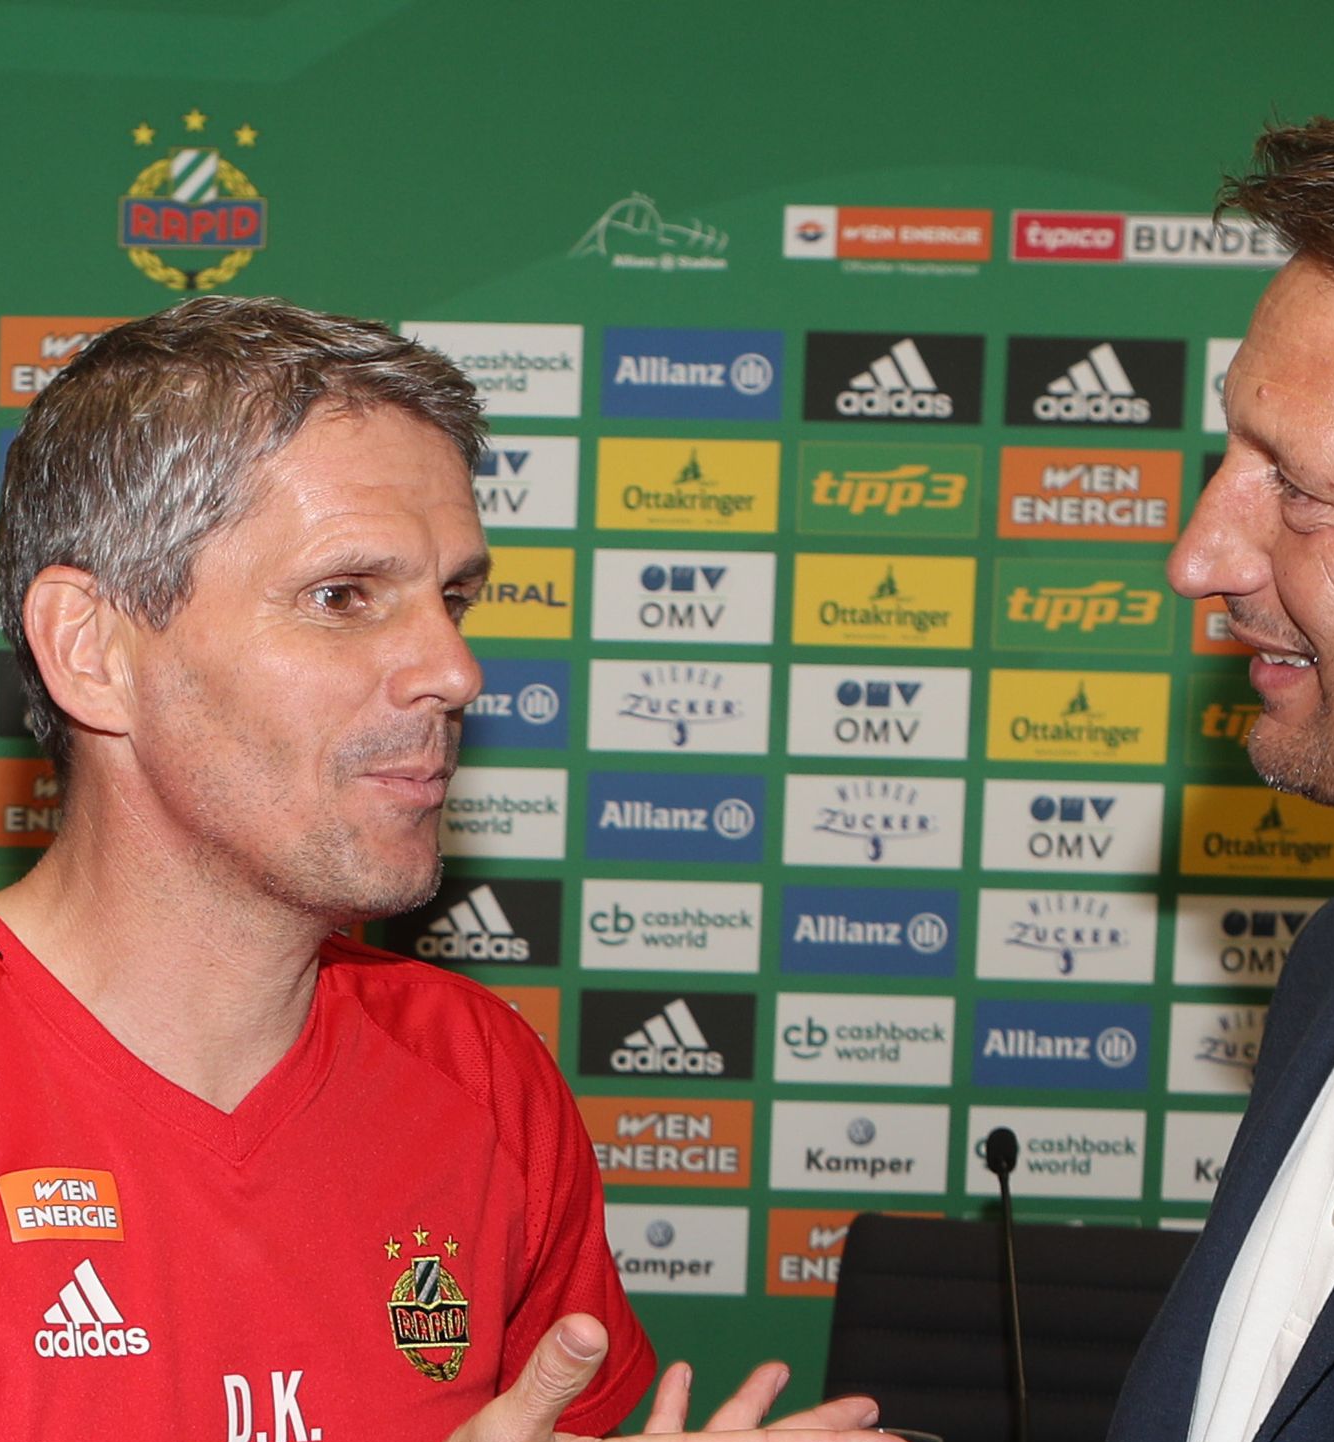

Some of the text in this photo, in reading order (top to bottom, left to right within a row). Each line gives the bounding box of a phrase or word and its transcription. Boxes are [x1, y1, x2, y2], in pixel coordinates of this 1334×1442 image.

[129, 203, 261, 242] RAPID
[900, 226, 982, 246] ENERGIE
[1024, 219, 1115, 250] tipico
[615, 355, 724, 387] Allianz
[835, 387, 953, 418] adidas
[1033, 391, 1151, 423] adidas
[812, 464, 967, 515] tipp3
[1043, 466, 1138, 492] WIEN
[622, 485, 754, 518] Ottakringer
[1012, 497, 1164, 527] ENERGIE
[639, 602, 724, 629] OMV
[818, 601, 949, 633] Ottakringer
[1008, 581, 1162, 631] tipp3
[834, 717, 919, 744] OMV
[1010, 713, 1140, 749] Ottakringer
[447, 795, 559, 815] cashback
[599, 800, 707, 831] Allianz
[448, 815, 512, 836] world
[1028, 832, 1112, 859] OMV
[641, 908, 755, 930] cashback
[793, 915, 901, 945] Allianz
[417, 931, 530, 961] adidas
[642, 930, 708, 949] world
[835, 1023, 945, 1043] cashback
[983, 1029, 1090, 1059] Allianz
[610, 1041, 724, 1075] adidas
[835, 1043, 900, 1063] world
[618, 1114, 710, 1139] WIEN
[805, 1141, 913, 1178] Kamper
[1027, 1136, 1136, 1156] cashback
[1027, 1157, 1092, 1175] world
[32, 1178, 97, 1203] WIEN
[16, 1204, 118, 1230] ENERGIE
[33, 1320, 151, 1358] adidas
[396, 1307, 467, 1342] RAPID
